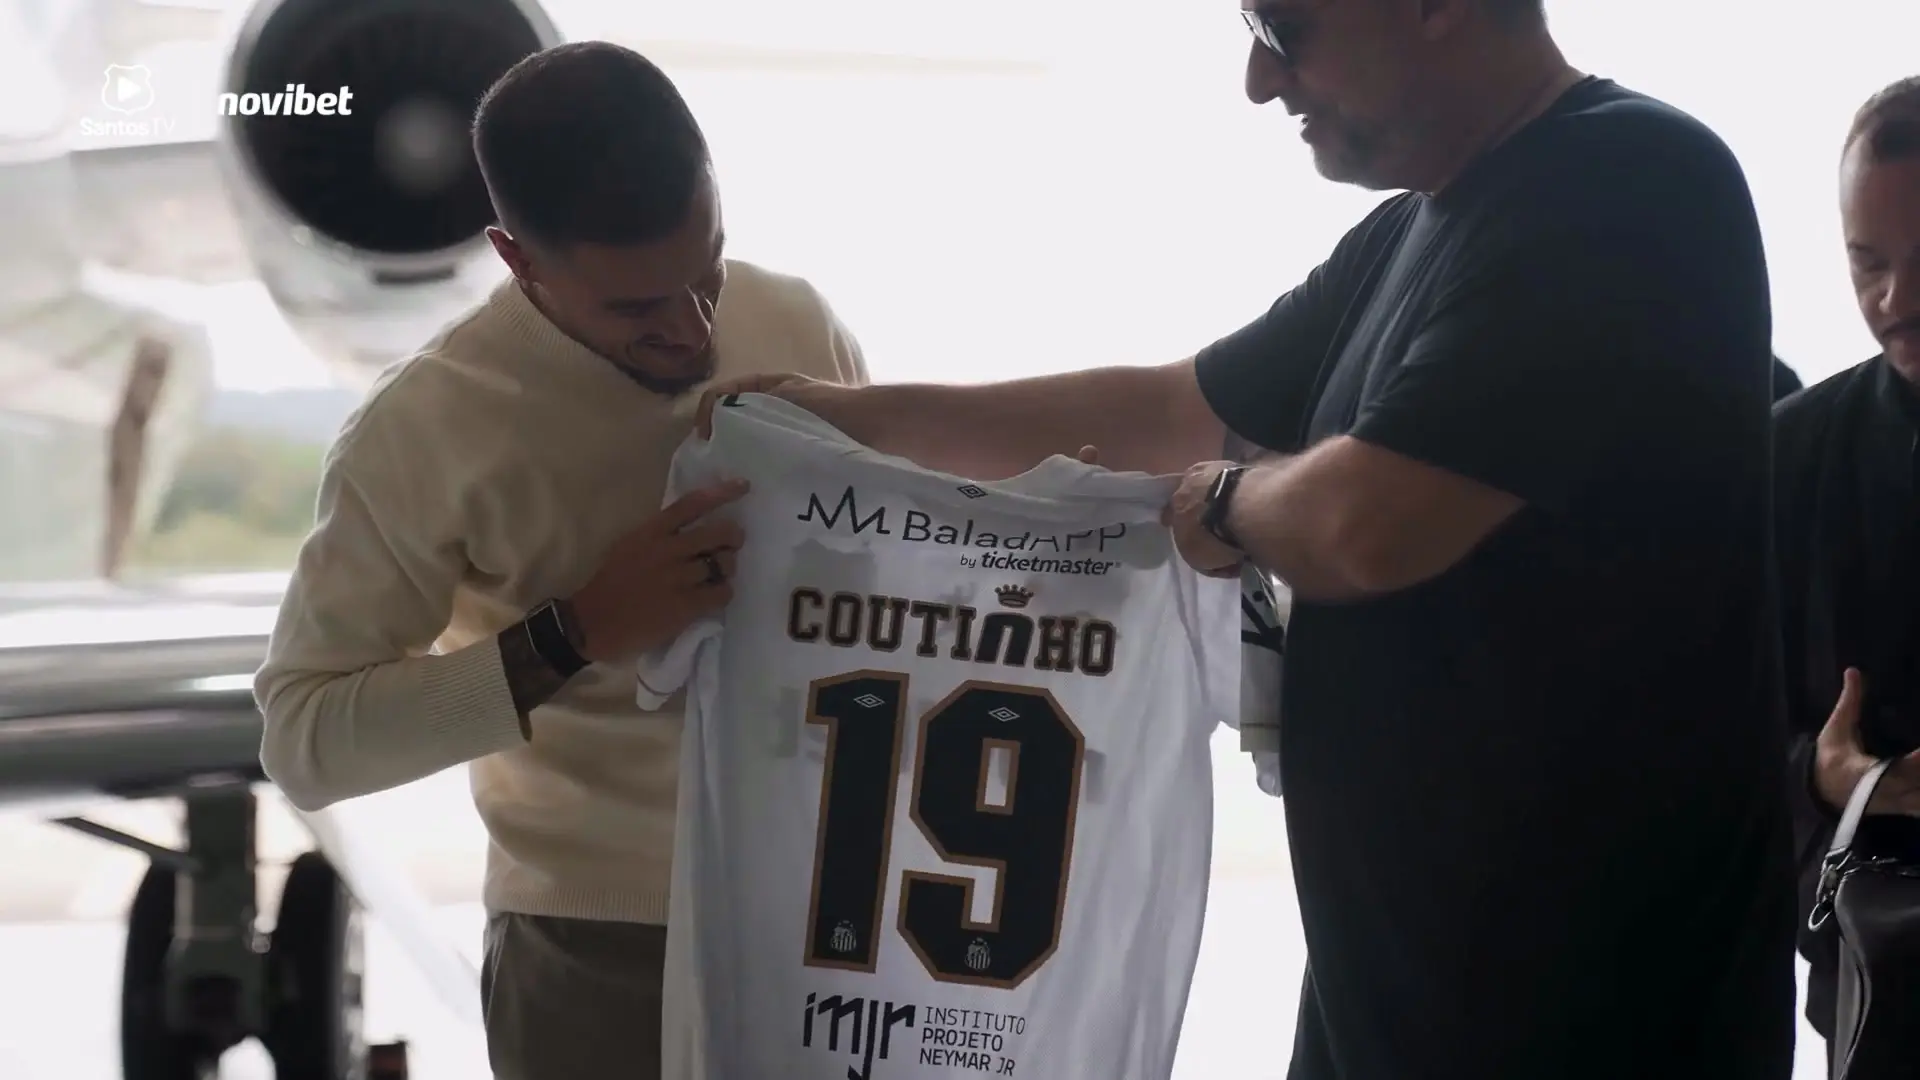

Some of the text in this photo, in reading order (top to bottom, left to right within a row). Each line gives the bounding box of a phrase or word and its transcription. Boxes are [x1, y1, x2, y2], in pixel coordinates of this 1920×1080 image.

[960, 551, 1114, 576] by ticketmaster
[787, 586, 1117, 677] COUTINHO
[804, 669, 1086, 989] 19
[924, 1006, 1026, 1036] INSTITUTO
[921, 1027, 1004, 1053] PROJETO
[918, 1047, 1016, 1077] NEYMAR JR
